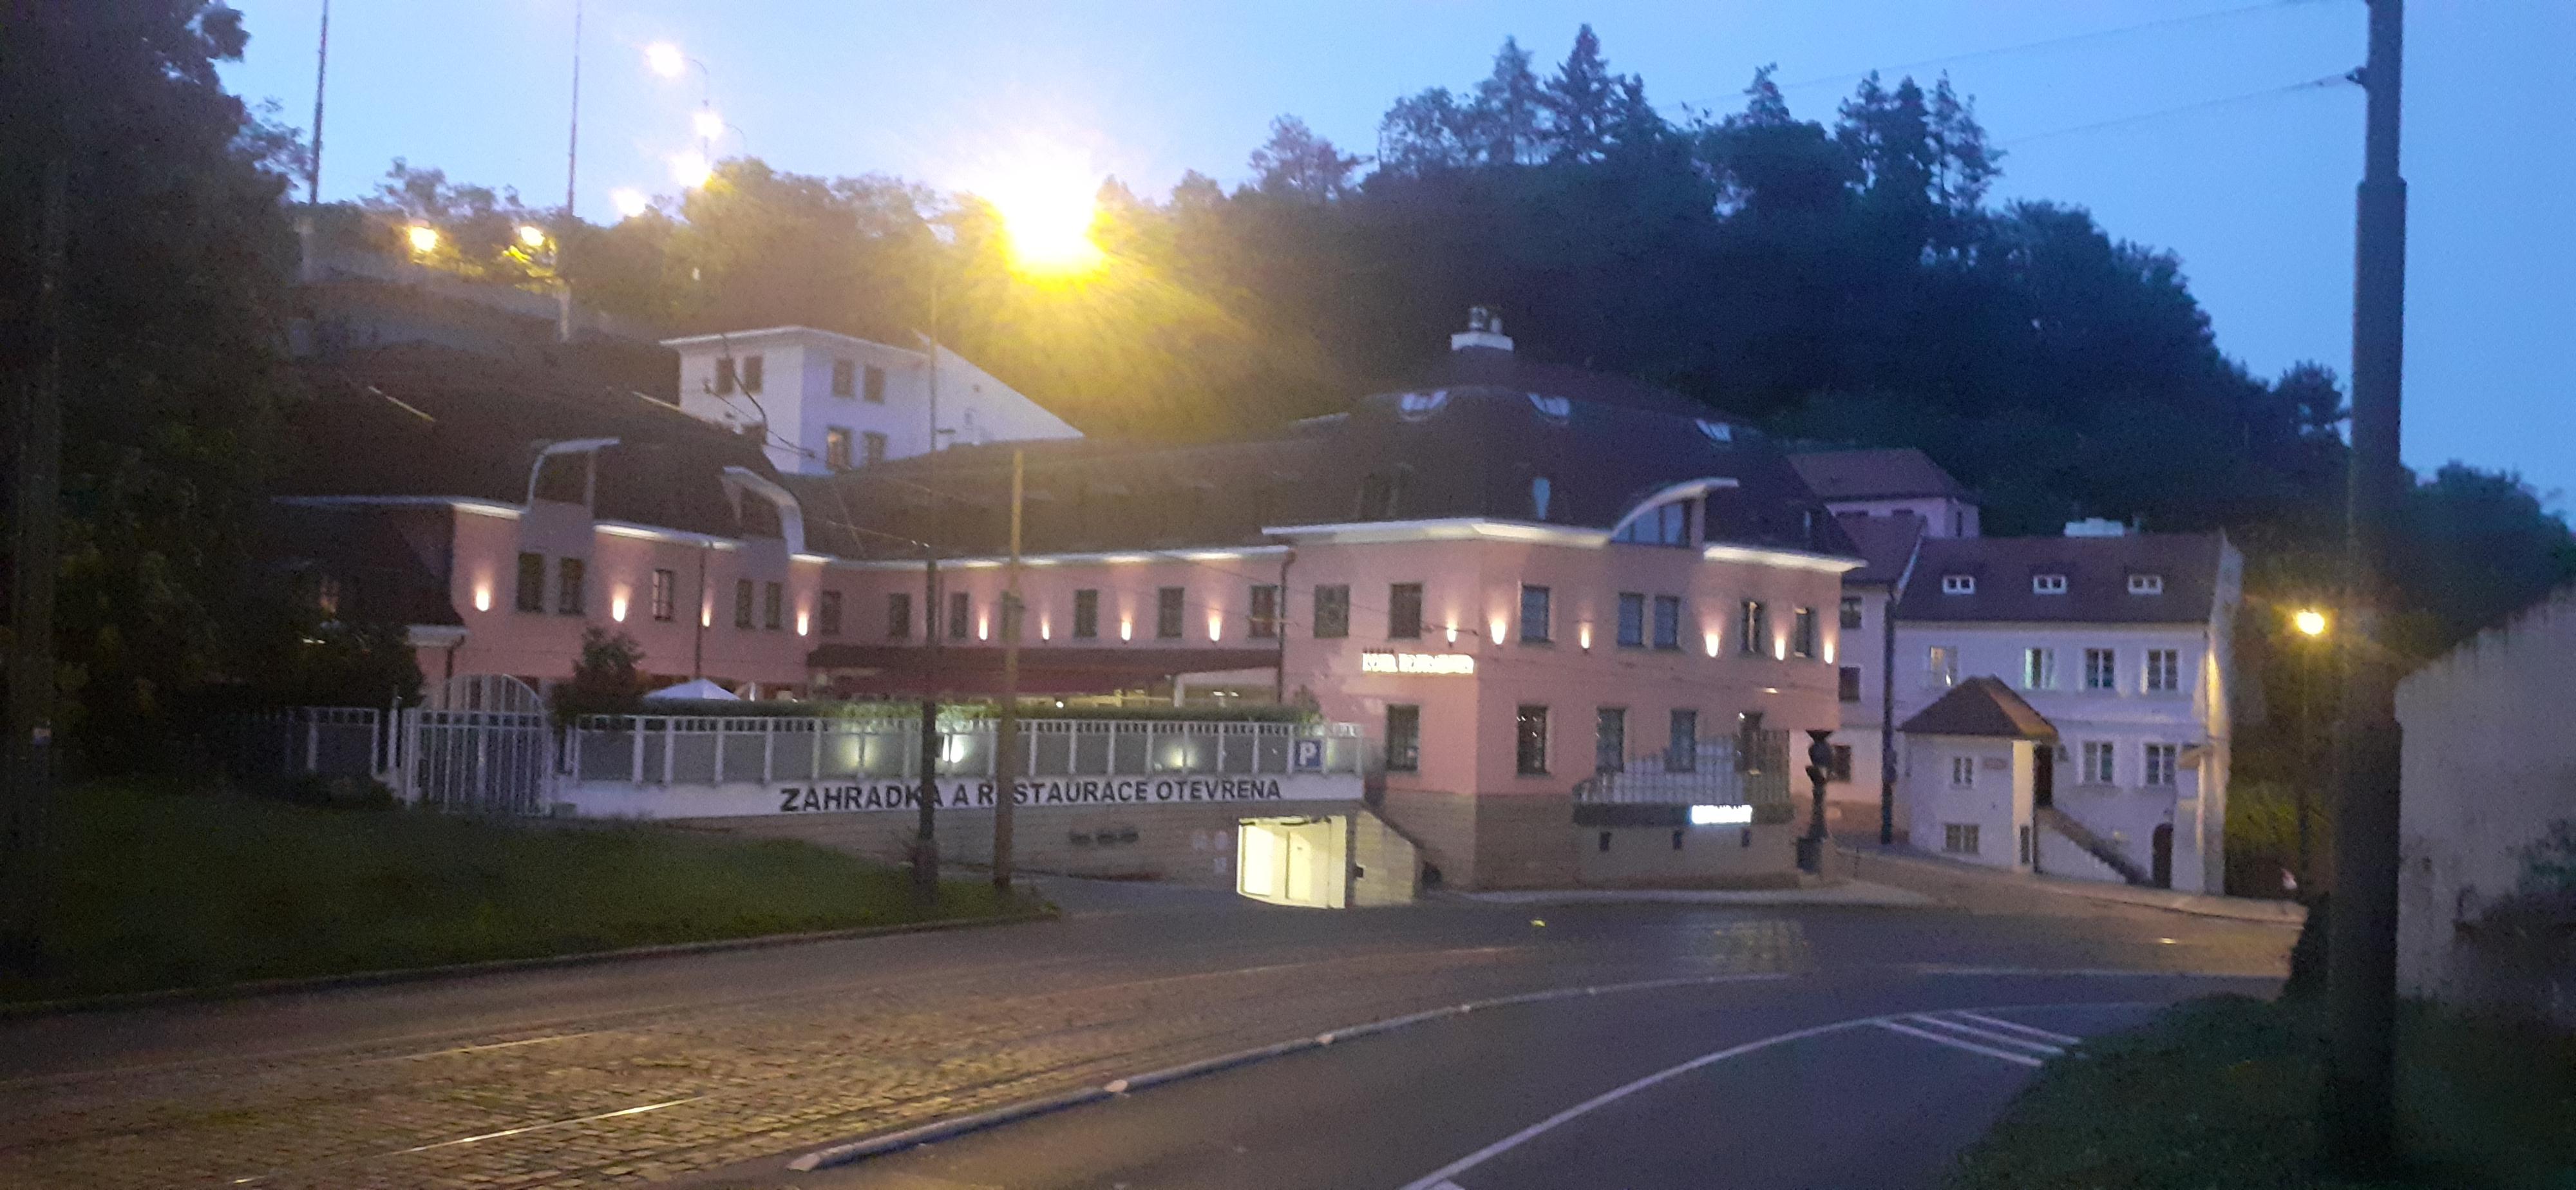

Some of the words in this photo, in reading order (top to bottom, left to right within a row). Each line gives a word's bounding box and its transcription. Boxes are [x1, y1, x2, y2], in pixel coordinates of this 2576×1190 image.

[1299, 741, 1317, 766] P
[952, 783, 969, 806] A
[978, 780, 1148, 806] RSTAURACE
